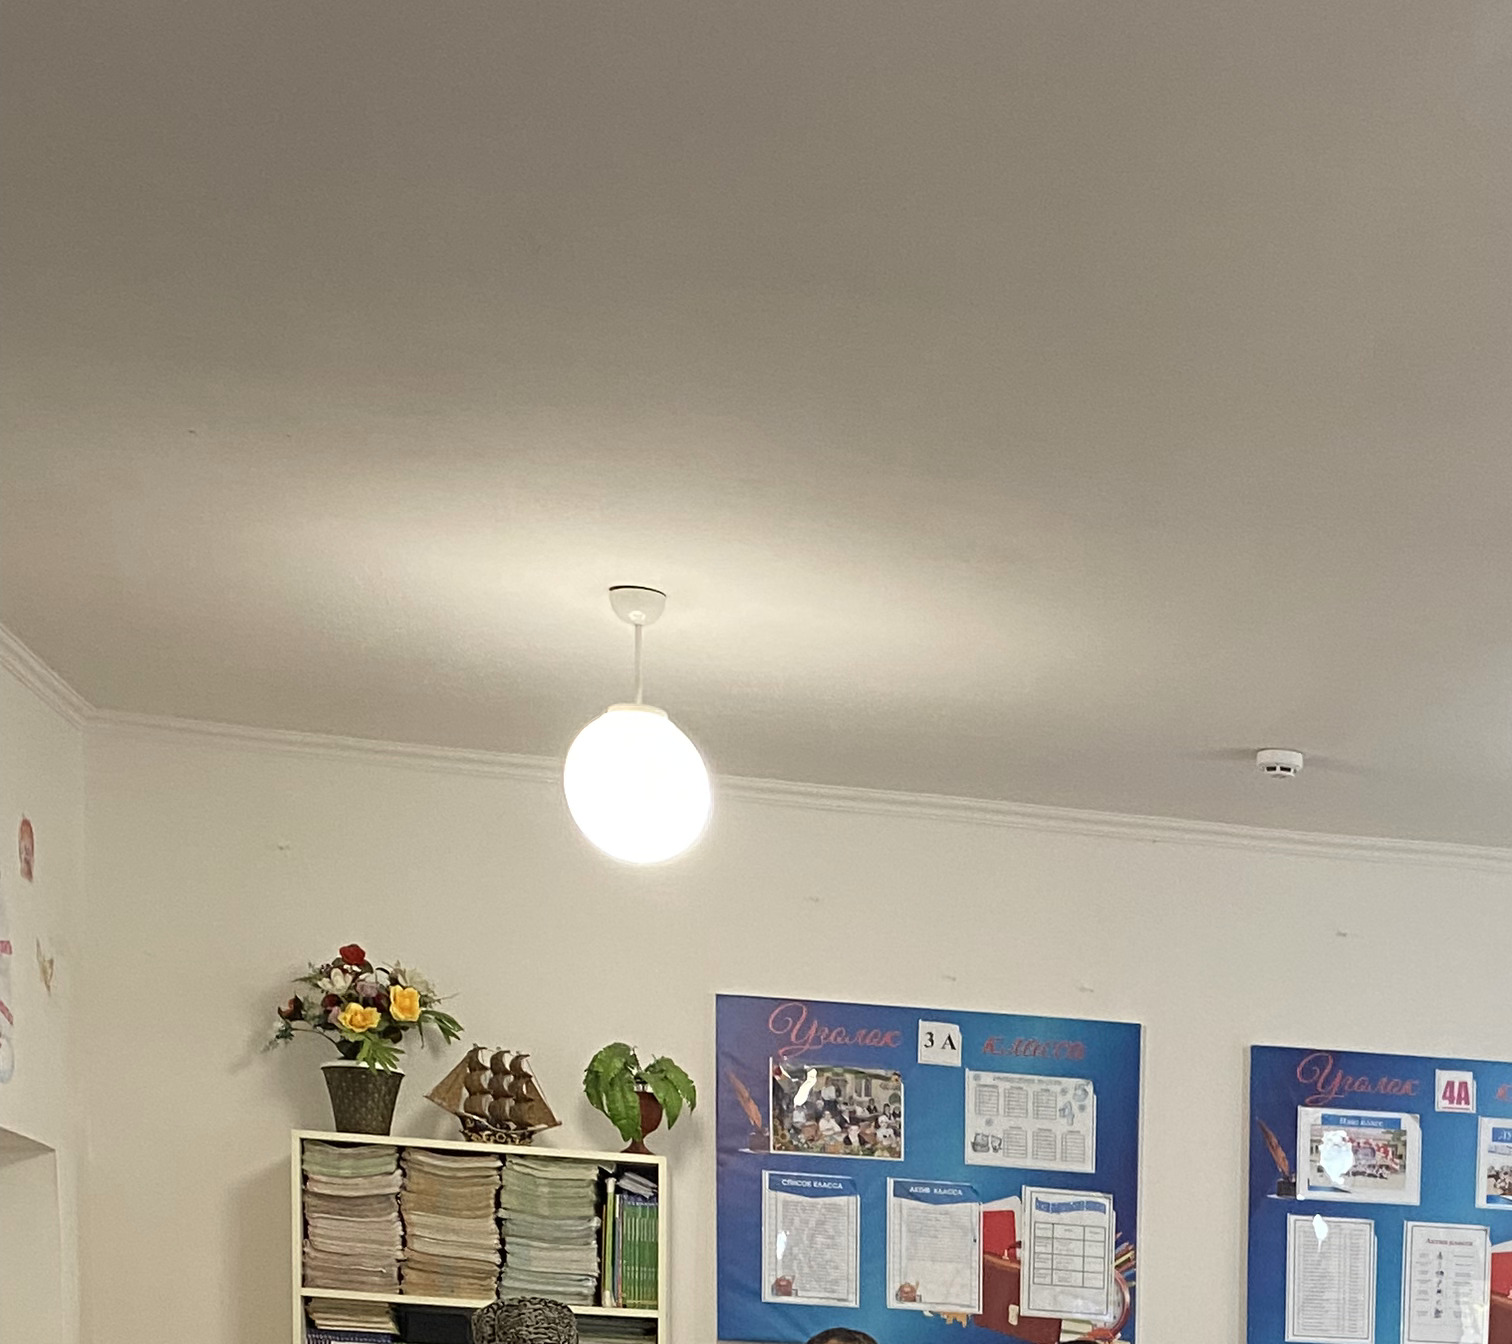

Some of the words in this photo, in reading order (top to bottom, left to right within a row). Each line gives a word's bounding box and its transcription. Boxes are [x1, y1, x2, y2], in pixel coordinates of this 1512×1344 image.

[768, 1001, 903, 1058] Уголок
[923, 1031, 935, 1049] 3
[1296, 1052, 1420, 1106] Уголок
